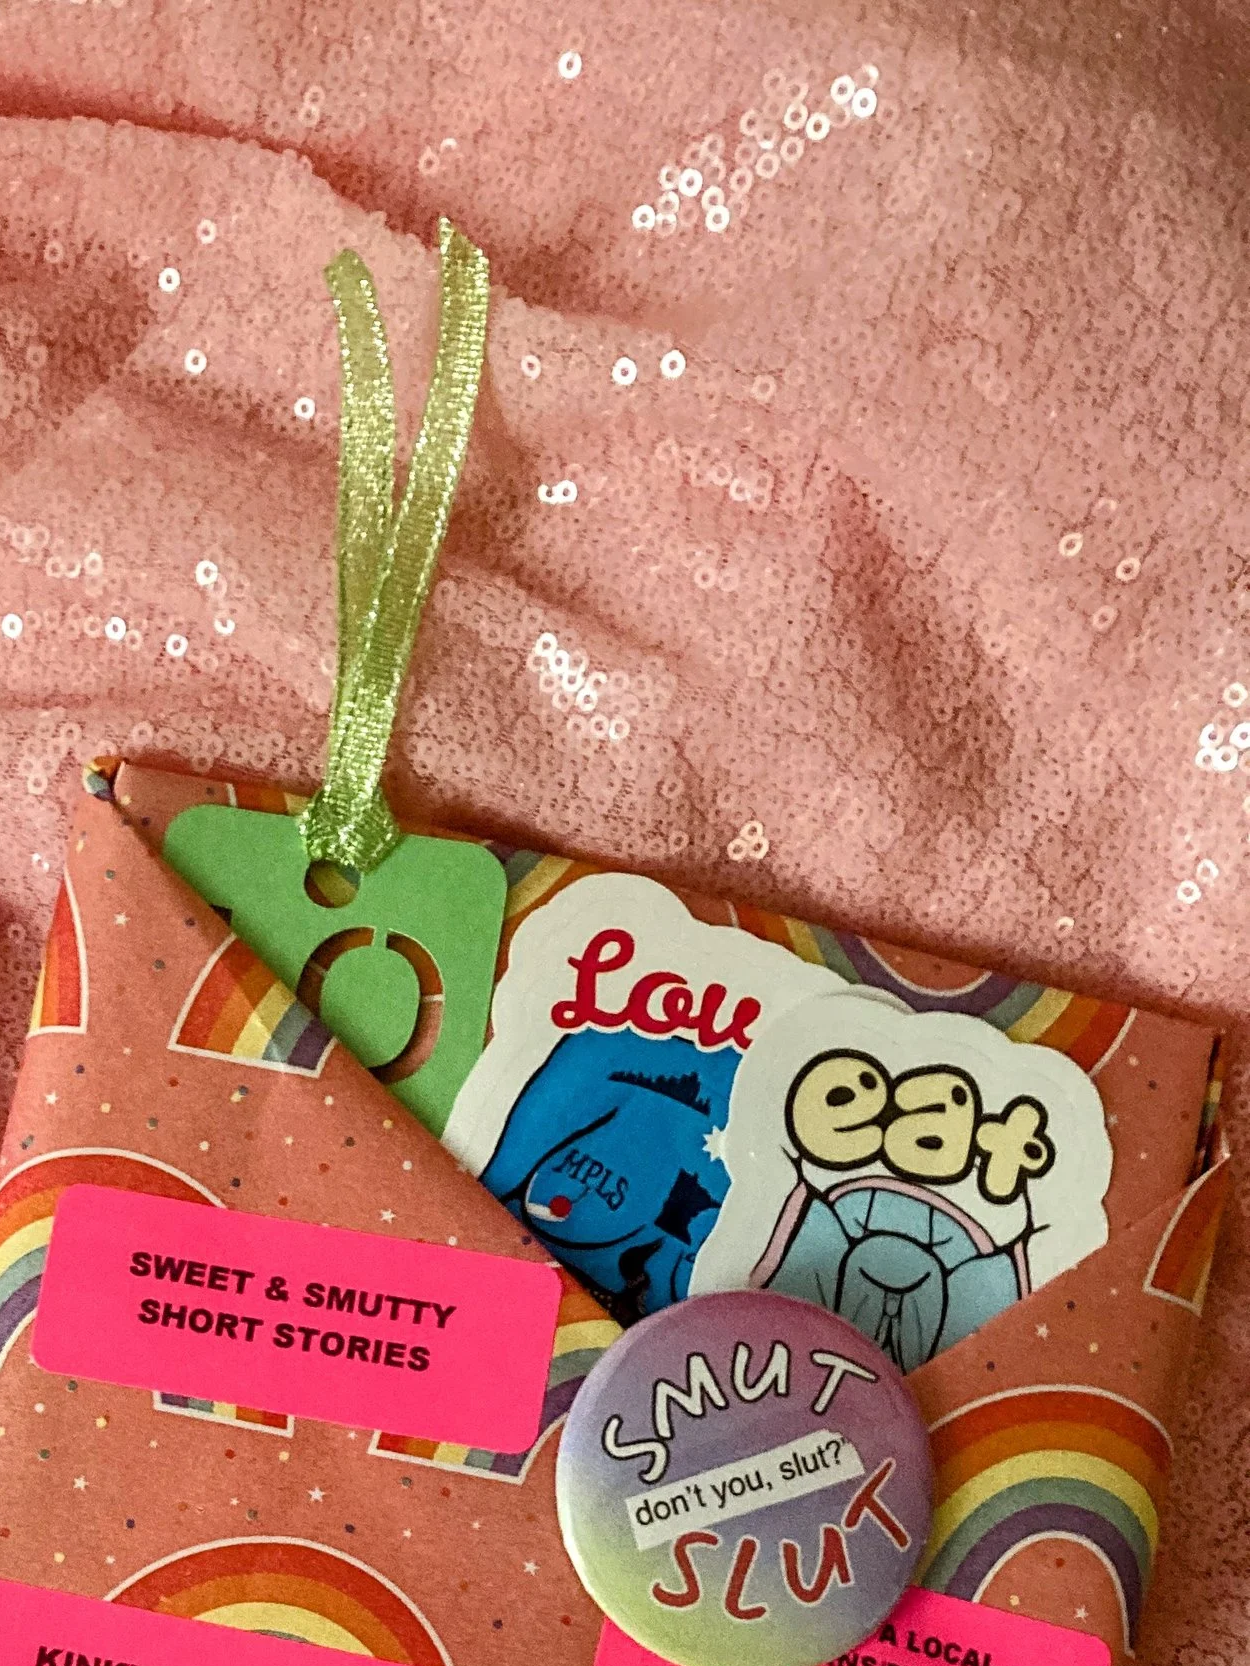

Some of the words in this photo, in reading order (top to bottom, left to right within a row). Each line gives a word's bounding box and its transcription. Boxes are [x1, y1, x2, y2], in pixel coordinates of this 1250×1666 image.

[551, 928, 761, 1051] Lov
[784, 1048, 1056, 1205] eat
[551, 1149, 629, 1212] MPLS
[129, 1251, 255, 1295] SWEET
[264, 1276, 289, 1302] &
[302, 1282, 457, 1329] SMUTTY
[138, 1298, 264, 1342] SHORT
[273, 1323, 430, 1372] STORIES
[601, 1339, 880, 1485] SMUT
[635, 1484, 707, 1526] don't
[710, 1470, 773, 1509] you,
[651, 1457, 912, 1622] SLUT
[878, 1622, 898, 1648] A
